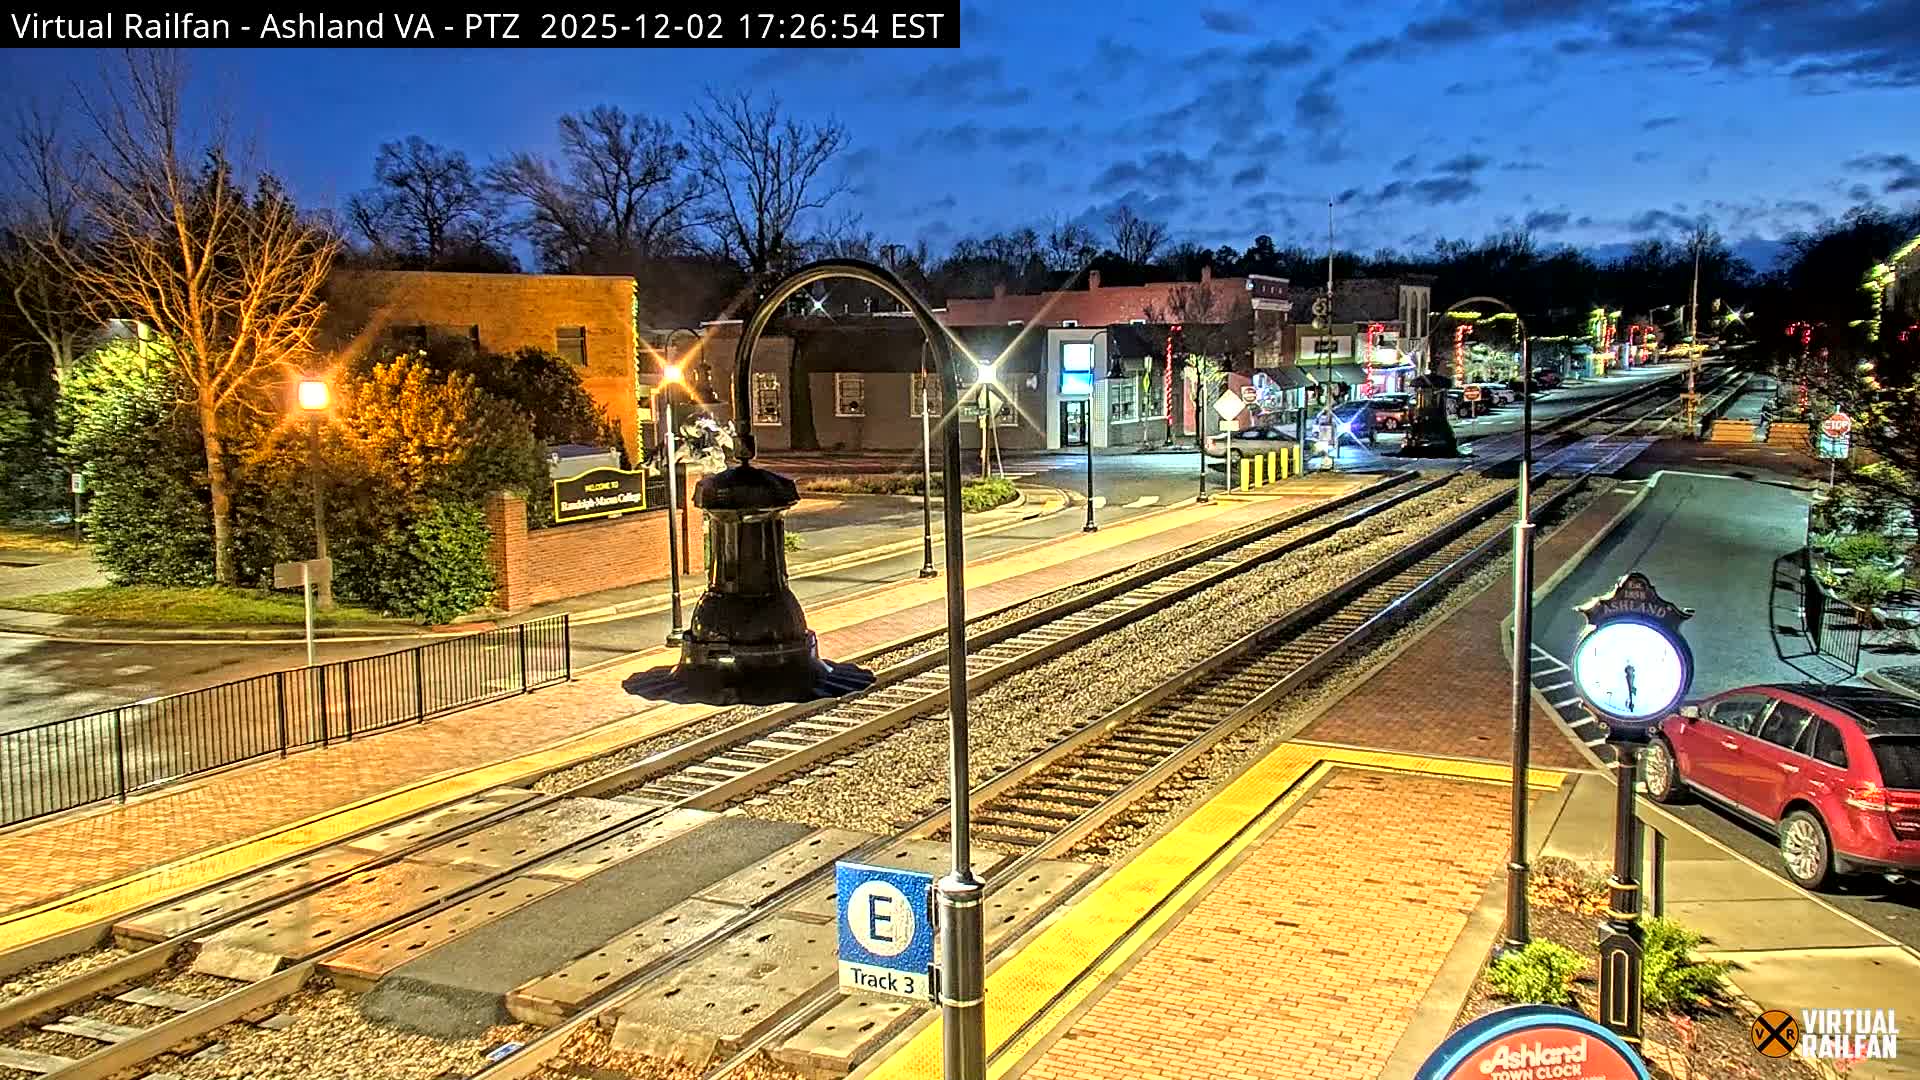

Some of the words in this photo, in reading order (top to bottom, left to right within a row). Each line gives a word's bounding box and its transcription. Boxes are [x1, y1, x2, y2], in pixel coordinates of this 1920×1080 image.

[1824, 419, 1849, 430] STOP
[1603, 600, 1667, 618] ASHLAND
[868, 894, 893, 943] E
[850, 967, 898, 992] Track
[903, 976, 915, 994] 3
[1479, 1037, 1588, 1074] Ashland
[1490, 1067, 1533, 1080] TOWN
[1535, 1063, 1582, 1080] CLOCK
